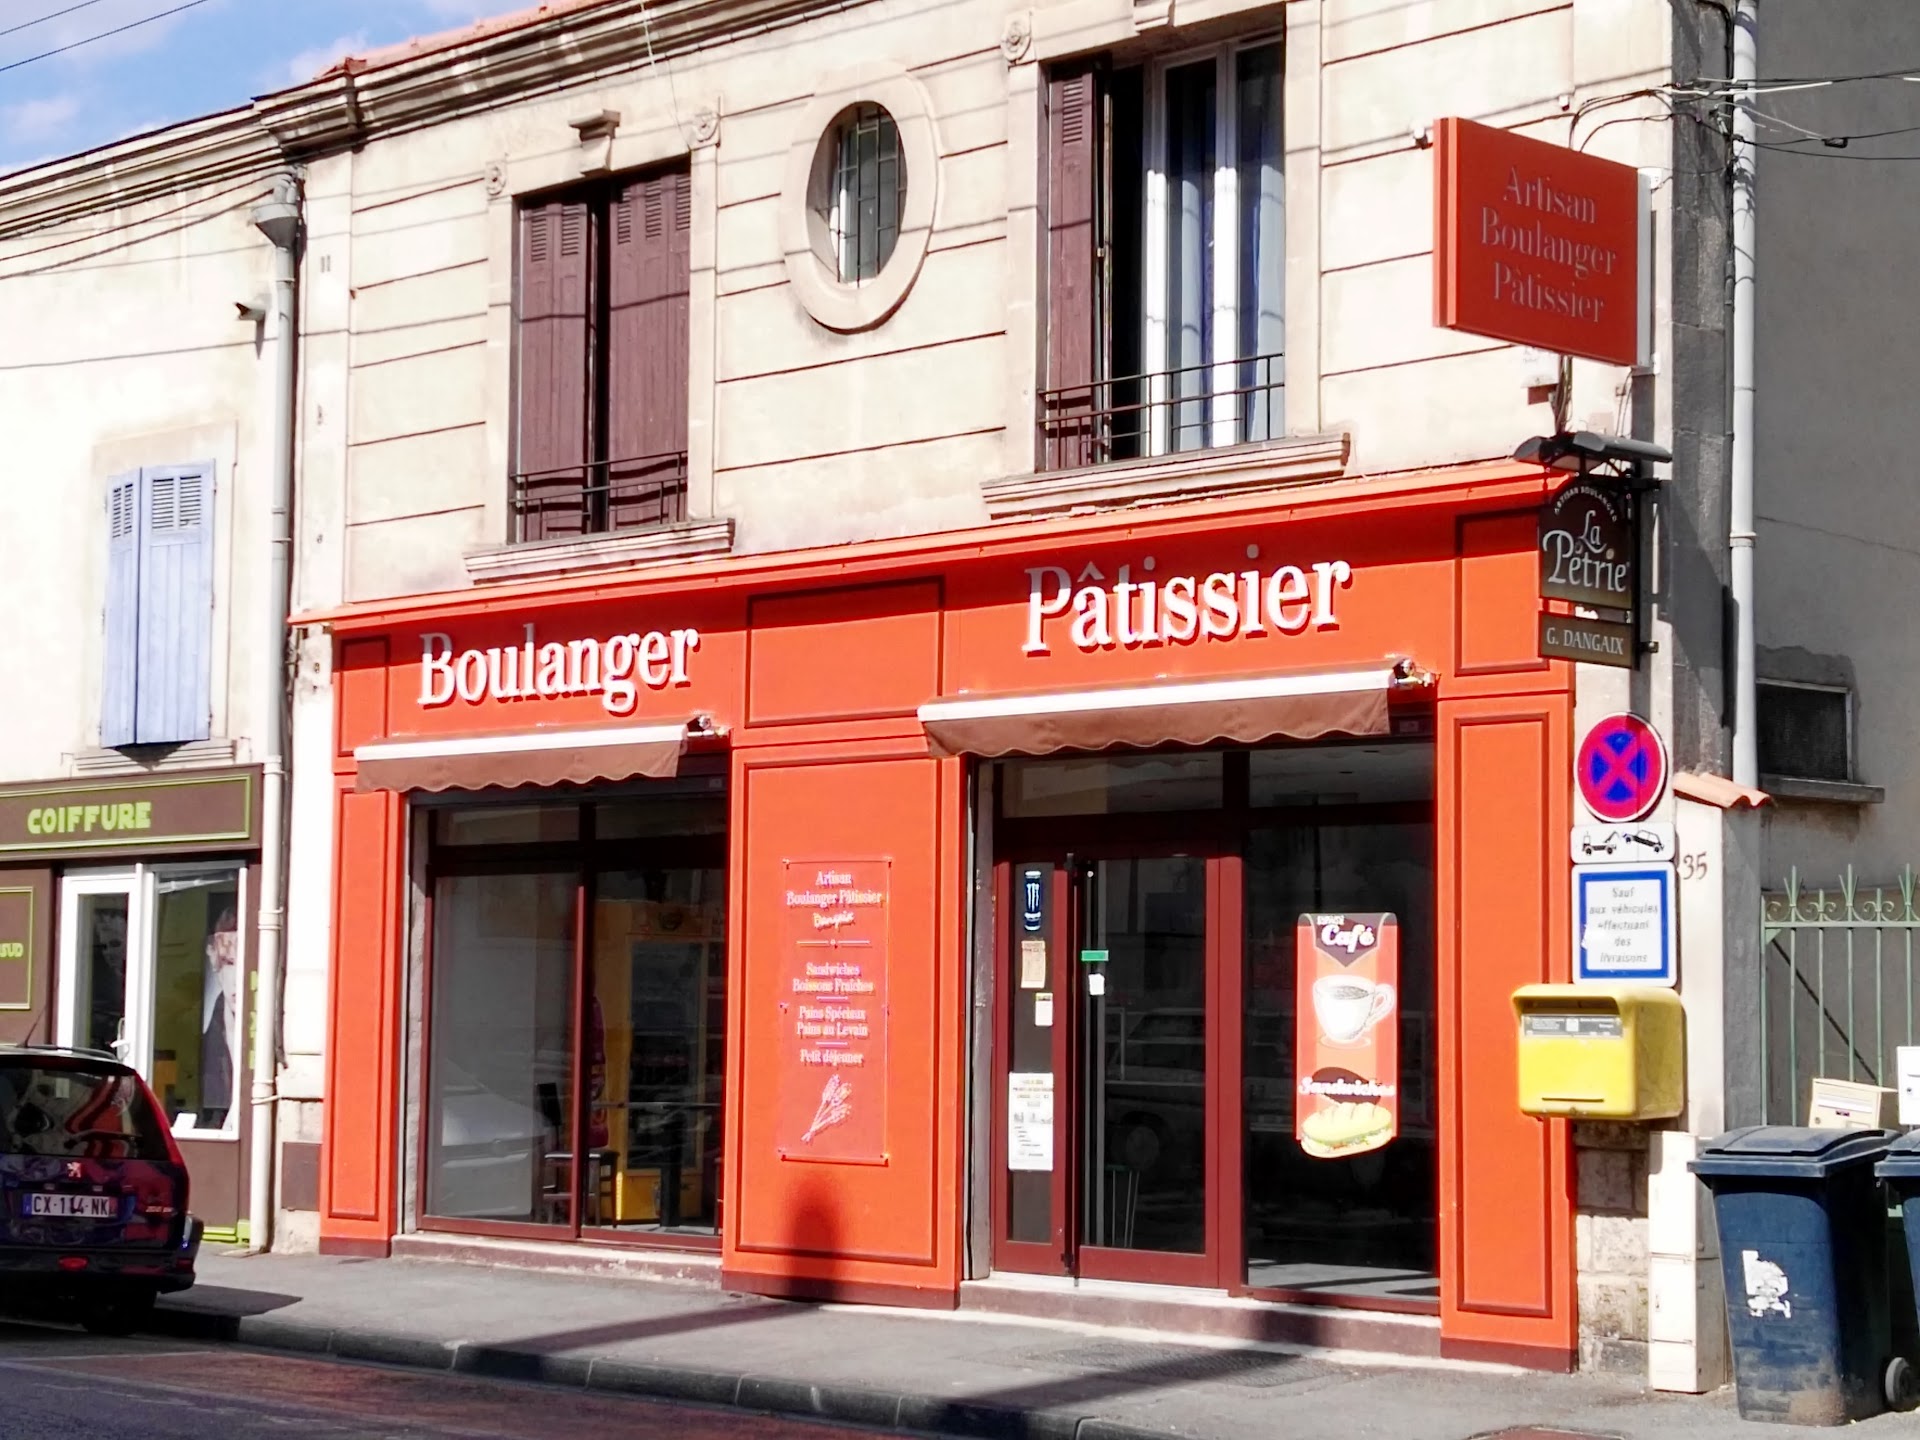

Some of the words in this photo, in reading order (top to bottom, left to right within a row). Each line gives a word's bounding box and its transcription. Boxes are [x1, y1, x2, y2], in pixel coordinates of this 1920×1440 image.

[1503, 165, 1596, 224] Artisan
[1481, 206, 1617, 280] Boulanger
[1580, 509, 1608, 554] La
[1021, 543, 1352, 652] Pâtissier
[1546, 627, 1559, 646] G.
[1563, 628, 1624, 656] DANGAIX
[417, 622, 699, 713] Boulanger
[27, 801, 152, 835] COIFFURE
[1683, 851, 1708, 881] 35
[786, 890, 838, 908] Boulanger
[1611, 886, 1635, 899] Sauf
[1320, 923, 1375, 953] Café
[1613, 935, 1632, 948] des
[1600, 951, 1648, 963] livraisons
